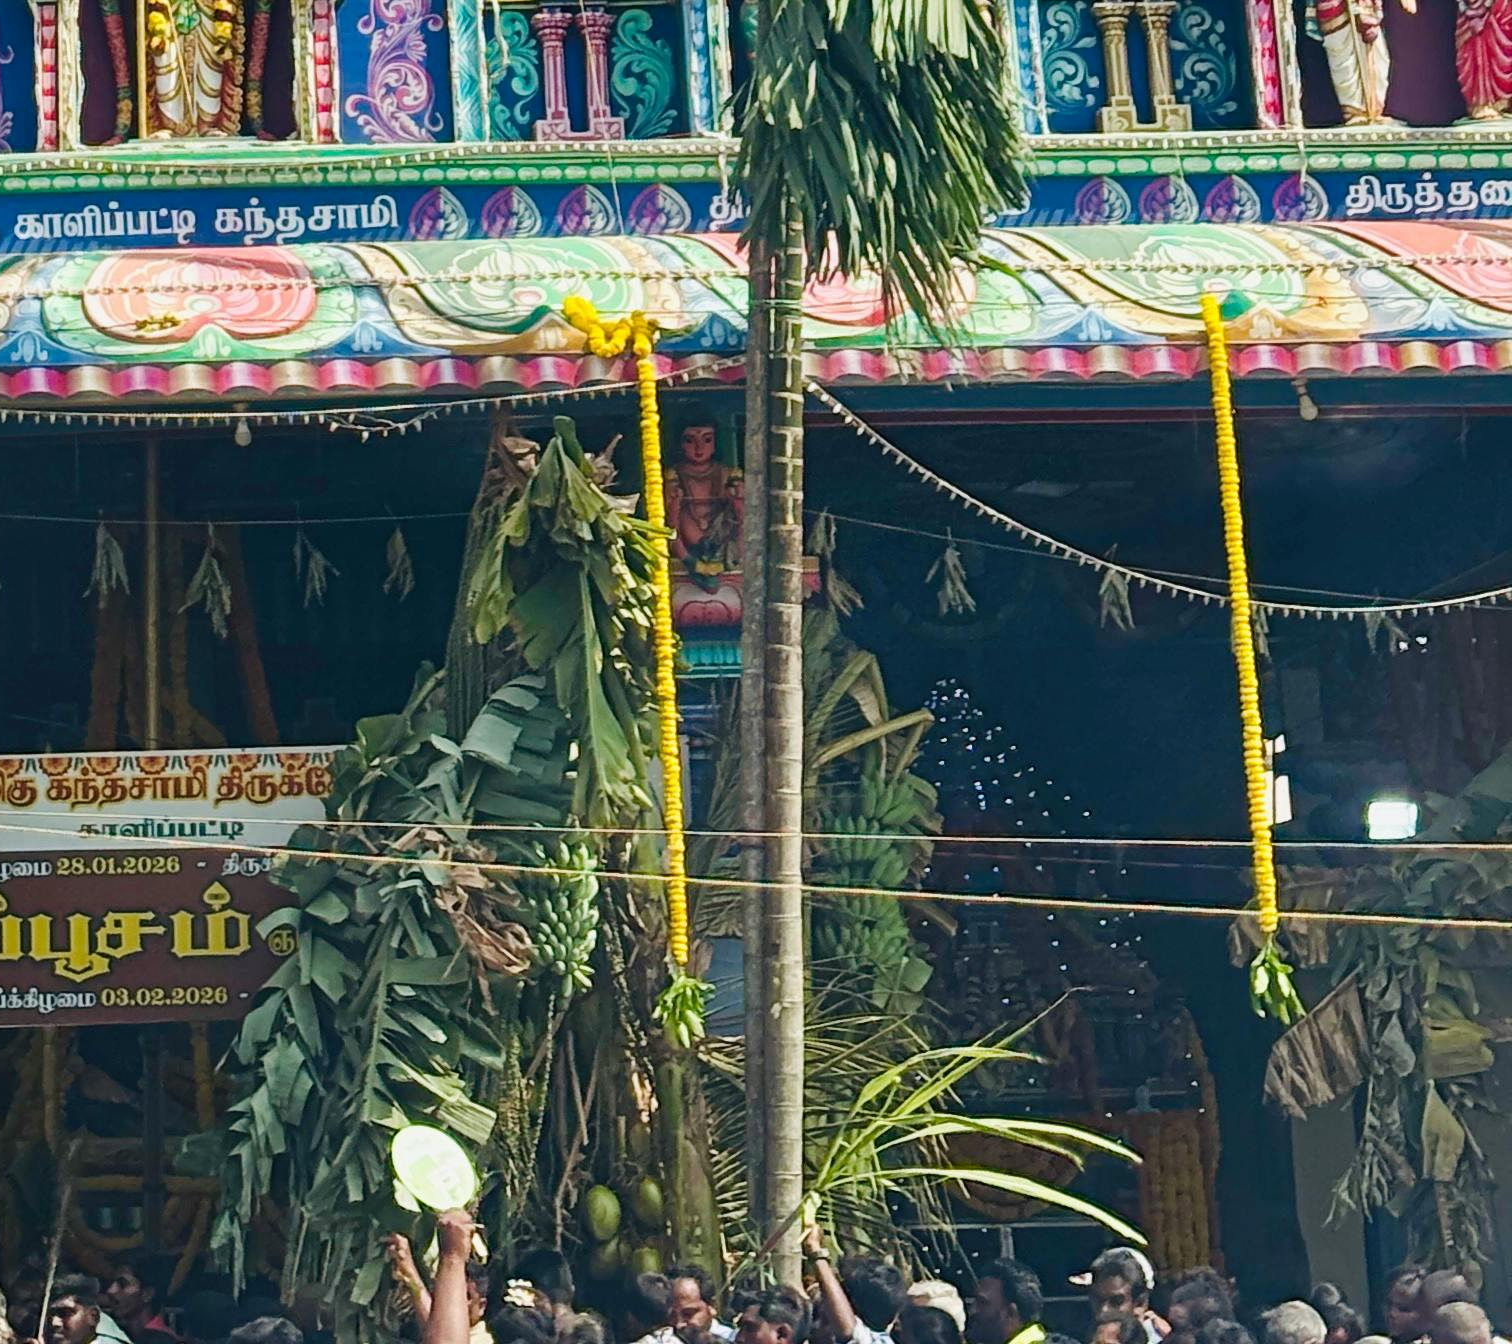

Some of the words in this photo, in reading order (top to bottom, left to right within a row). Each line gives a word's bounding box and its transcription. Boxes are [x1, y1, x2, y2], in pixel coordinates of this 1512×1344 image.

[14, 201, 197, 244] காளிப்பட்டி
[216, 196, 399, 245] கந்தசாமி
[47, 765, 208, 810] கந்தசாமி
[56, 856, 181, 876] 28.01.2026
[100, 987, 228, 1008] 03.02.2026
